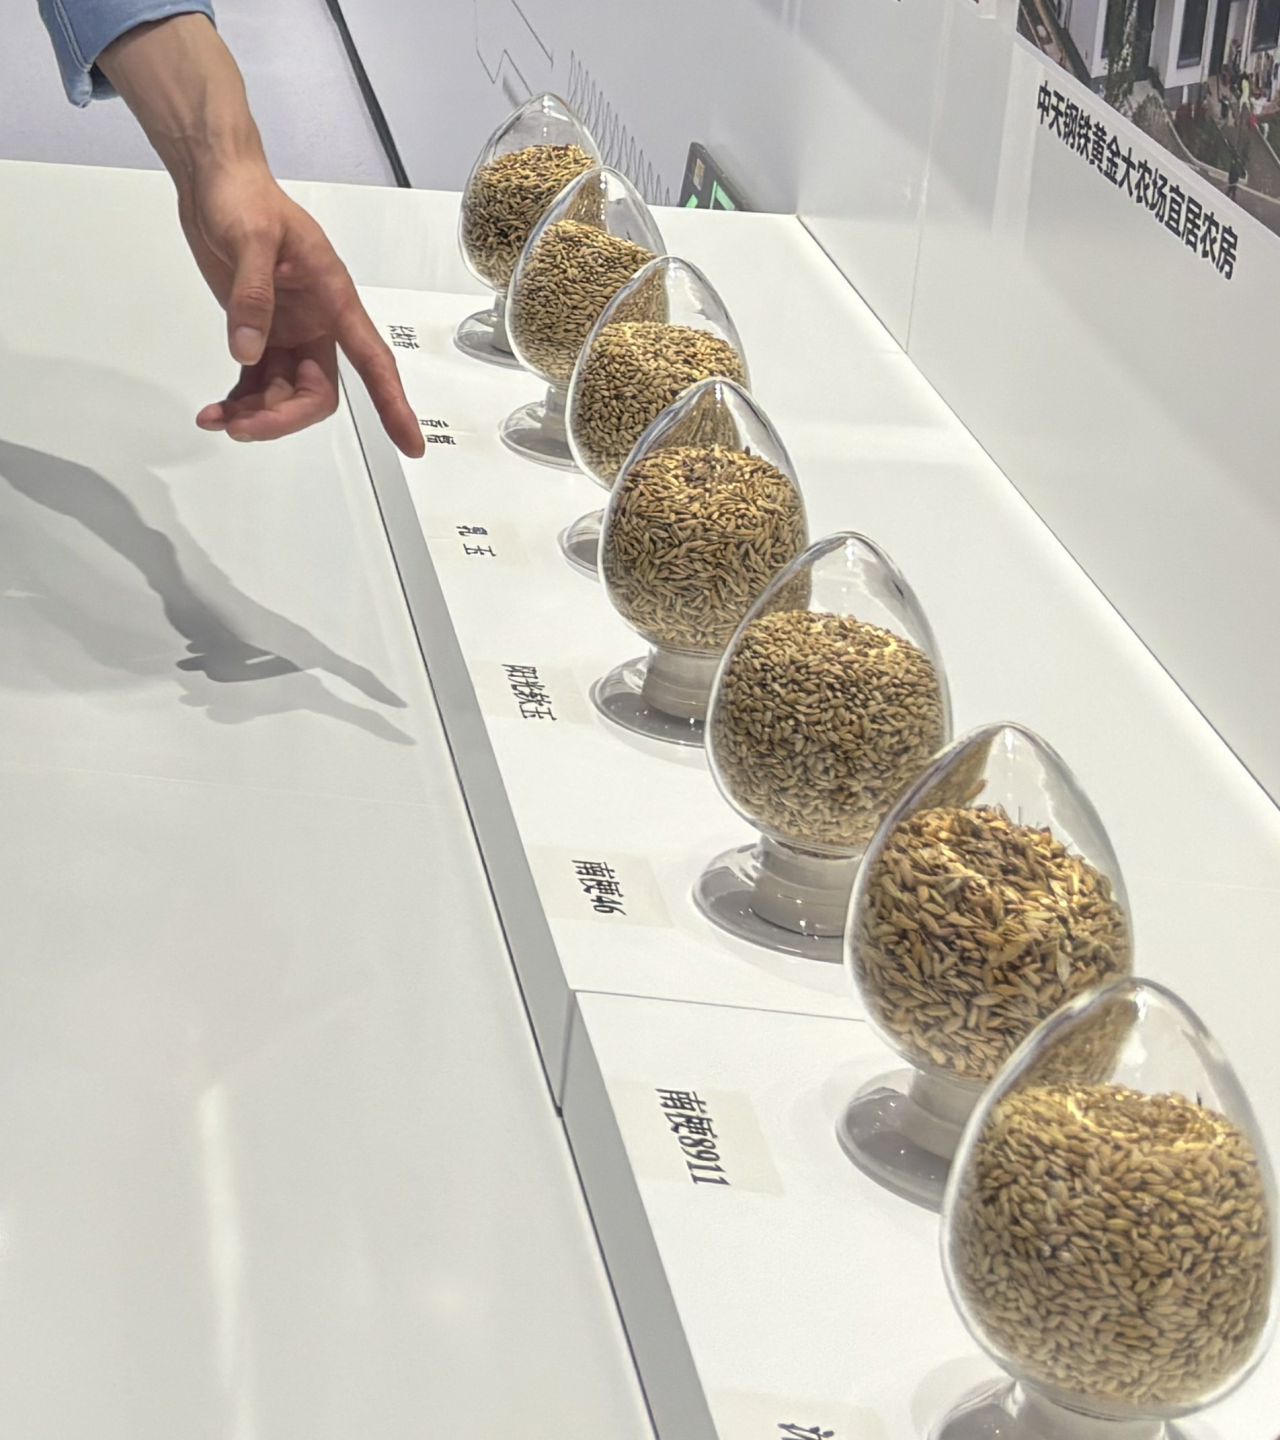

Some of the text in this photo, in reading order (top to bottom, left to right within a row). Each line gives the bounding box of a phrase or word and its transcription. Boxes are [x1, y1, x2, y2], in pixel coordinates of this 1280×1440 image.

[1037, 79, 1239, 280] 中天钢铁黄金大农场宜居农房
